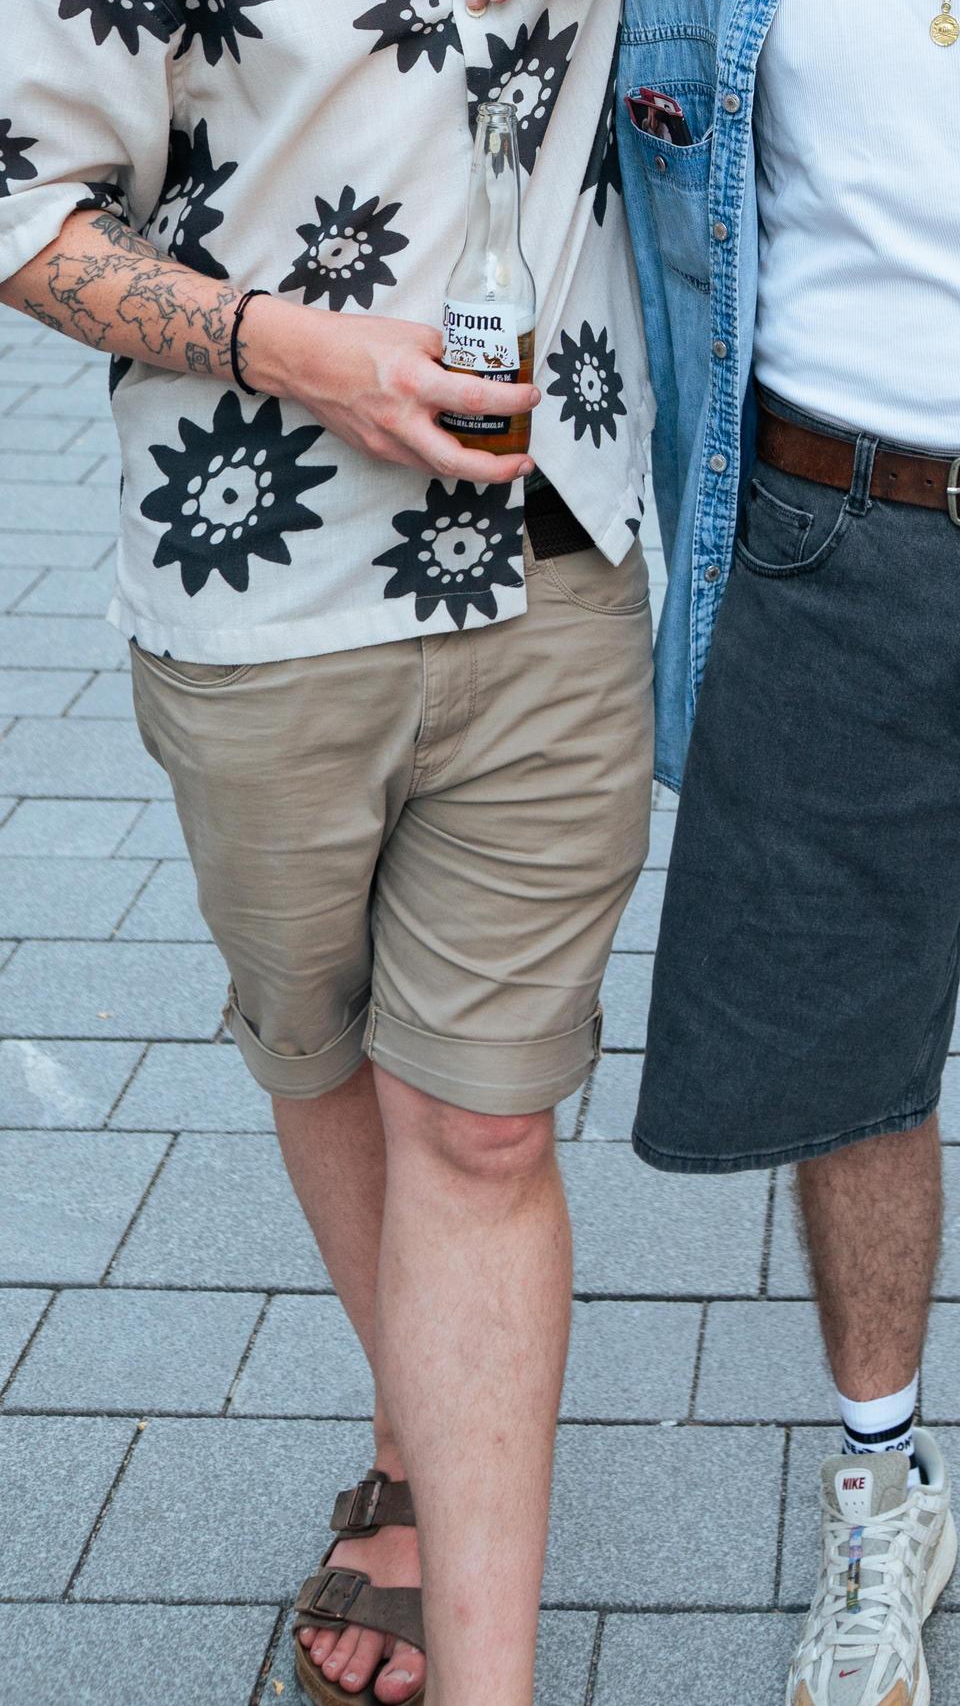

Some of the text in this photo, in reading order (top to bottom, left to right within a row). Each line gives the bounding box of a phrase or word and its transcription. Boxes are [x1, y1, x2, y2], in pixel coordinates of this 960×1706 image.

[443, 302, 503, 332] Corona
[446, 327, 486, 349] Extra
[842, 1476, 866, 1491] NIKE
